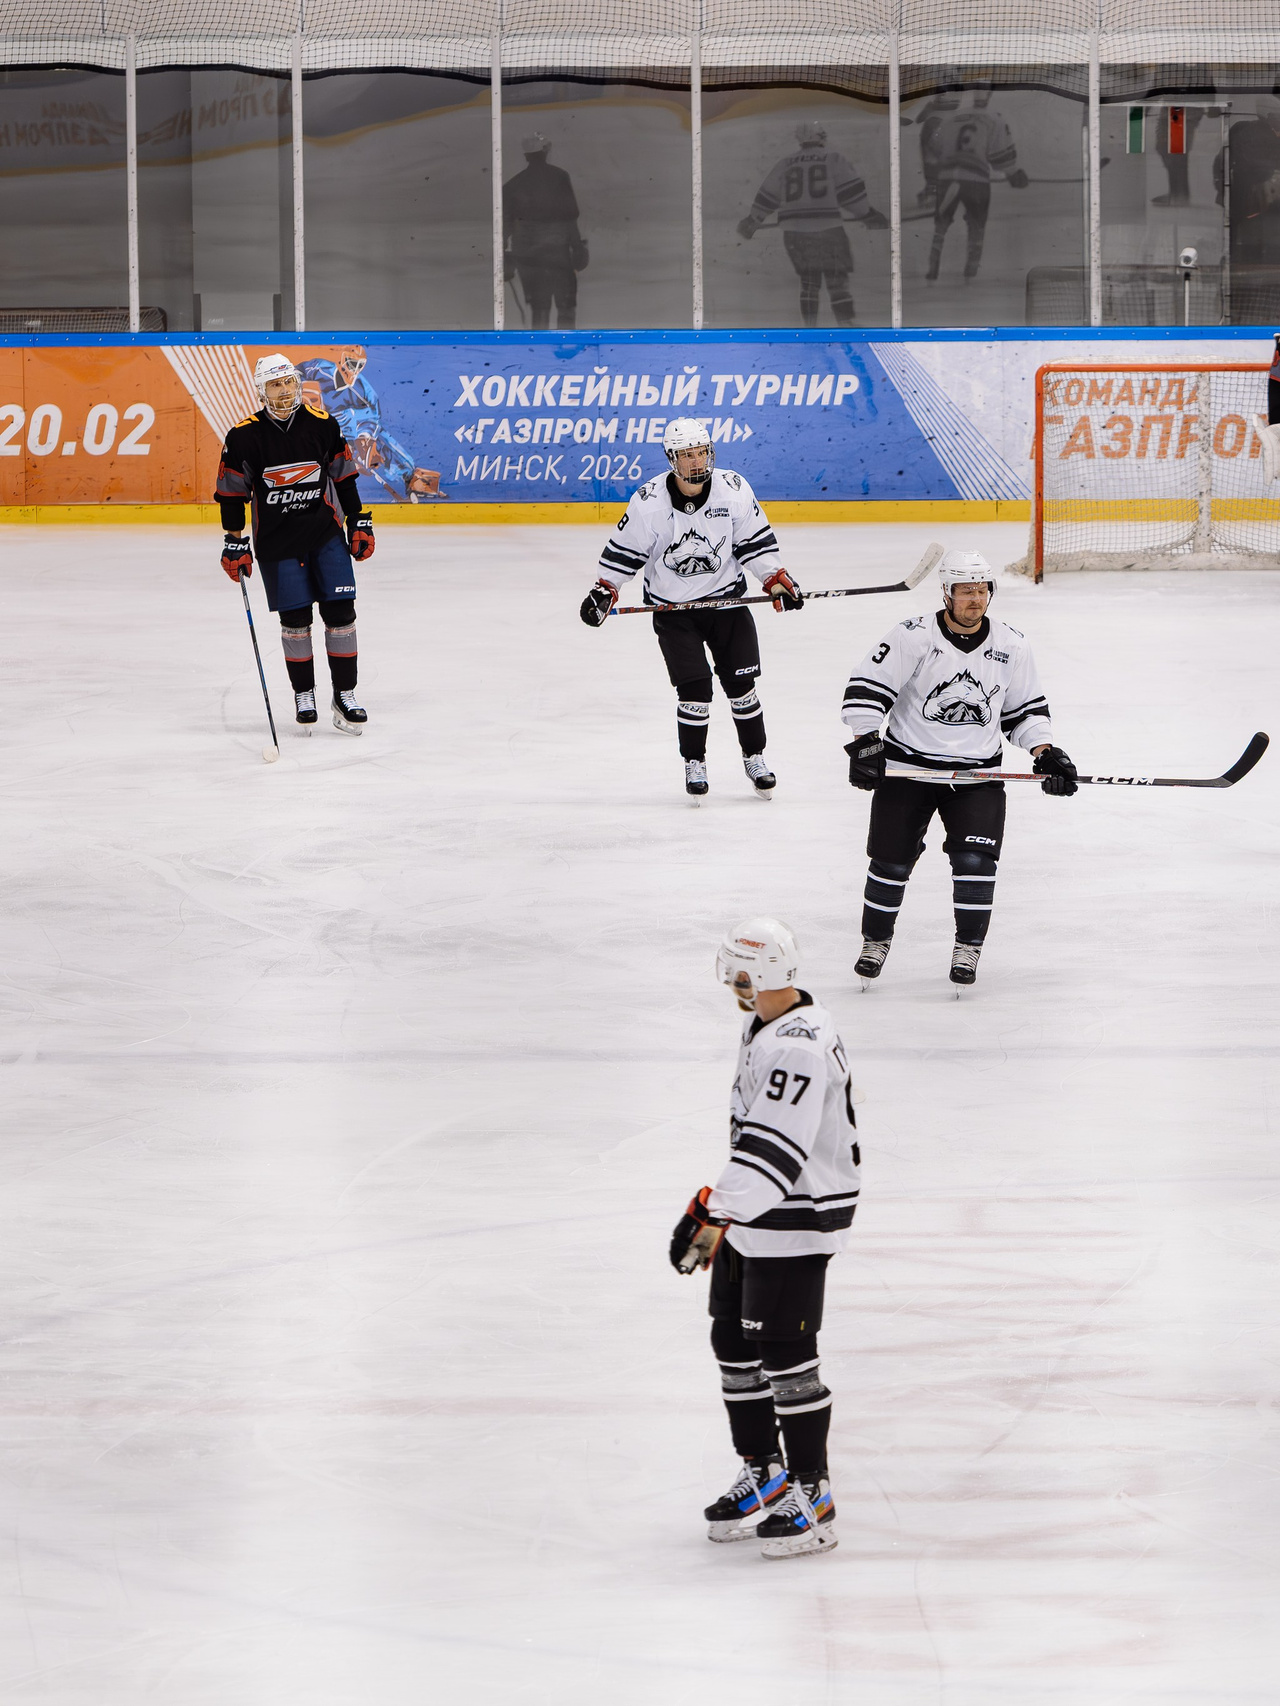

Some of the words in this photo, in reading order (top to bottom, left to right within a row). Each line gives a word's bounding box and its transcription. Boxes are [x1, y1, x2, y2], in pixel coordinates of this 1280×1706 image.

[453, 366, 701, 407] ХОККЕЙНЫЙ
[711, 374, 860, 407] ТУРНИР
[453, 418, 619, 444] «ГАЗПРОМ
[624, 417, 754, 443] НЕТИ»
[454, 454, 568, 485] МИНСК,
[577, 454, 642, 481] 2026
[671, 600, 732, 612] JETSPEED
[871, 642, 891, 665] 3
[734, 664, 760, 676] CCM
[1090, 775, 1155, 786] CCM
[964, 835, 998, 847] CCM
[766, 1068, 812, 1106] 97
